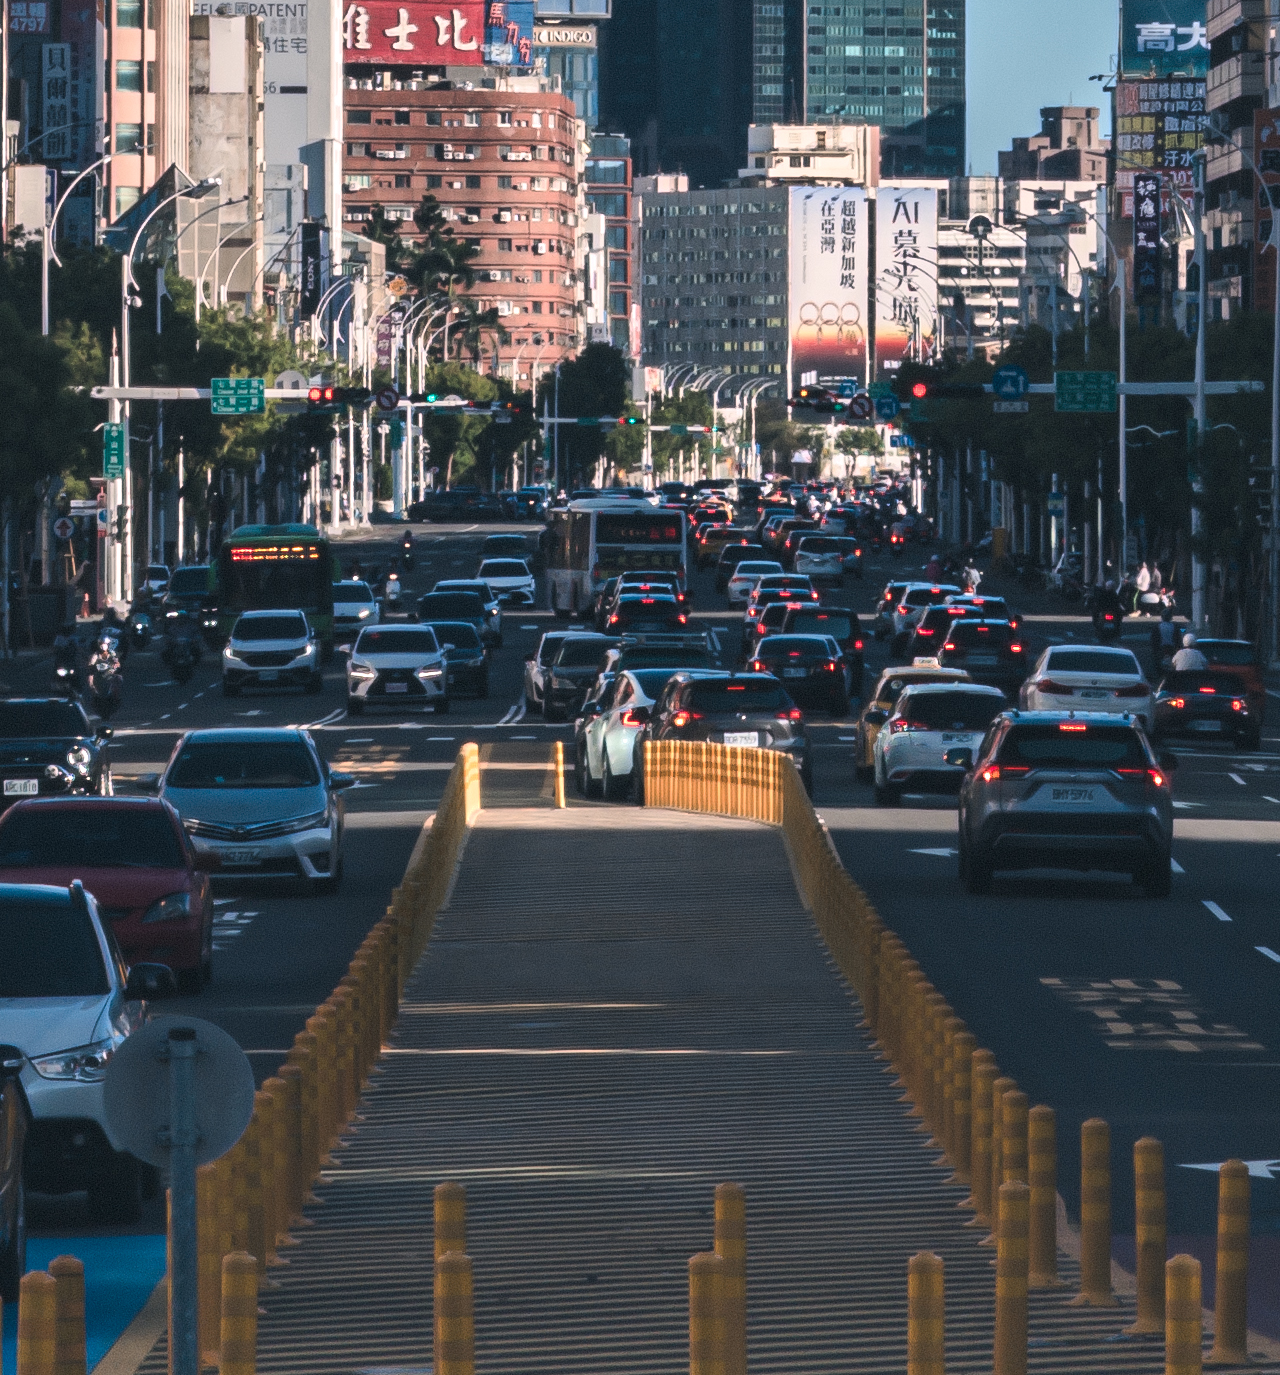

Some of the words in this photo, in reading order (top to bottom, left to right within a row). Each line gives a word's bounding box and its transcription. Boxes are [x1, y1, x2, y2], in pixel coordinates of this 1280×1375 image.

[249, 3, 308, 17] PATENT
[549, 30, 592, 44] INDIGO
[820, 199, 836, 254] 在亞灣
[840, 199, 856, 290] 超越新加坡
